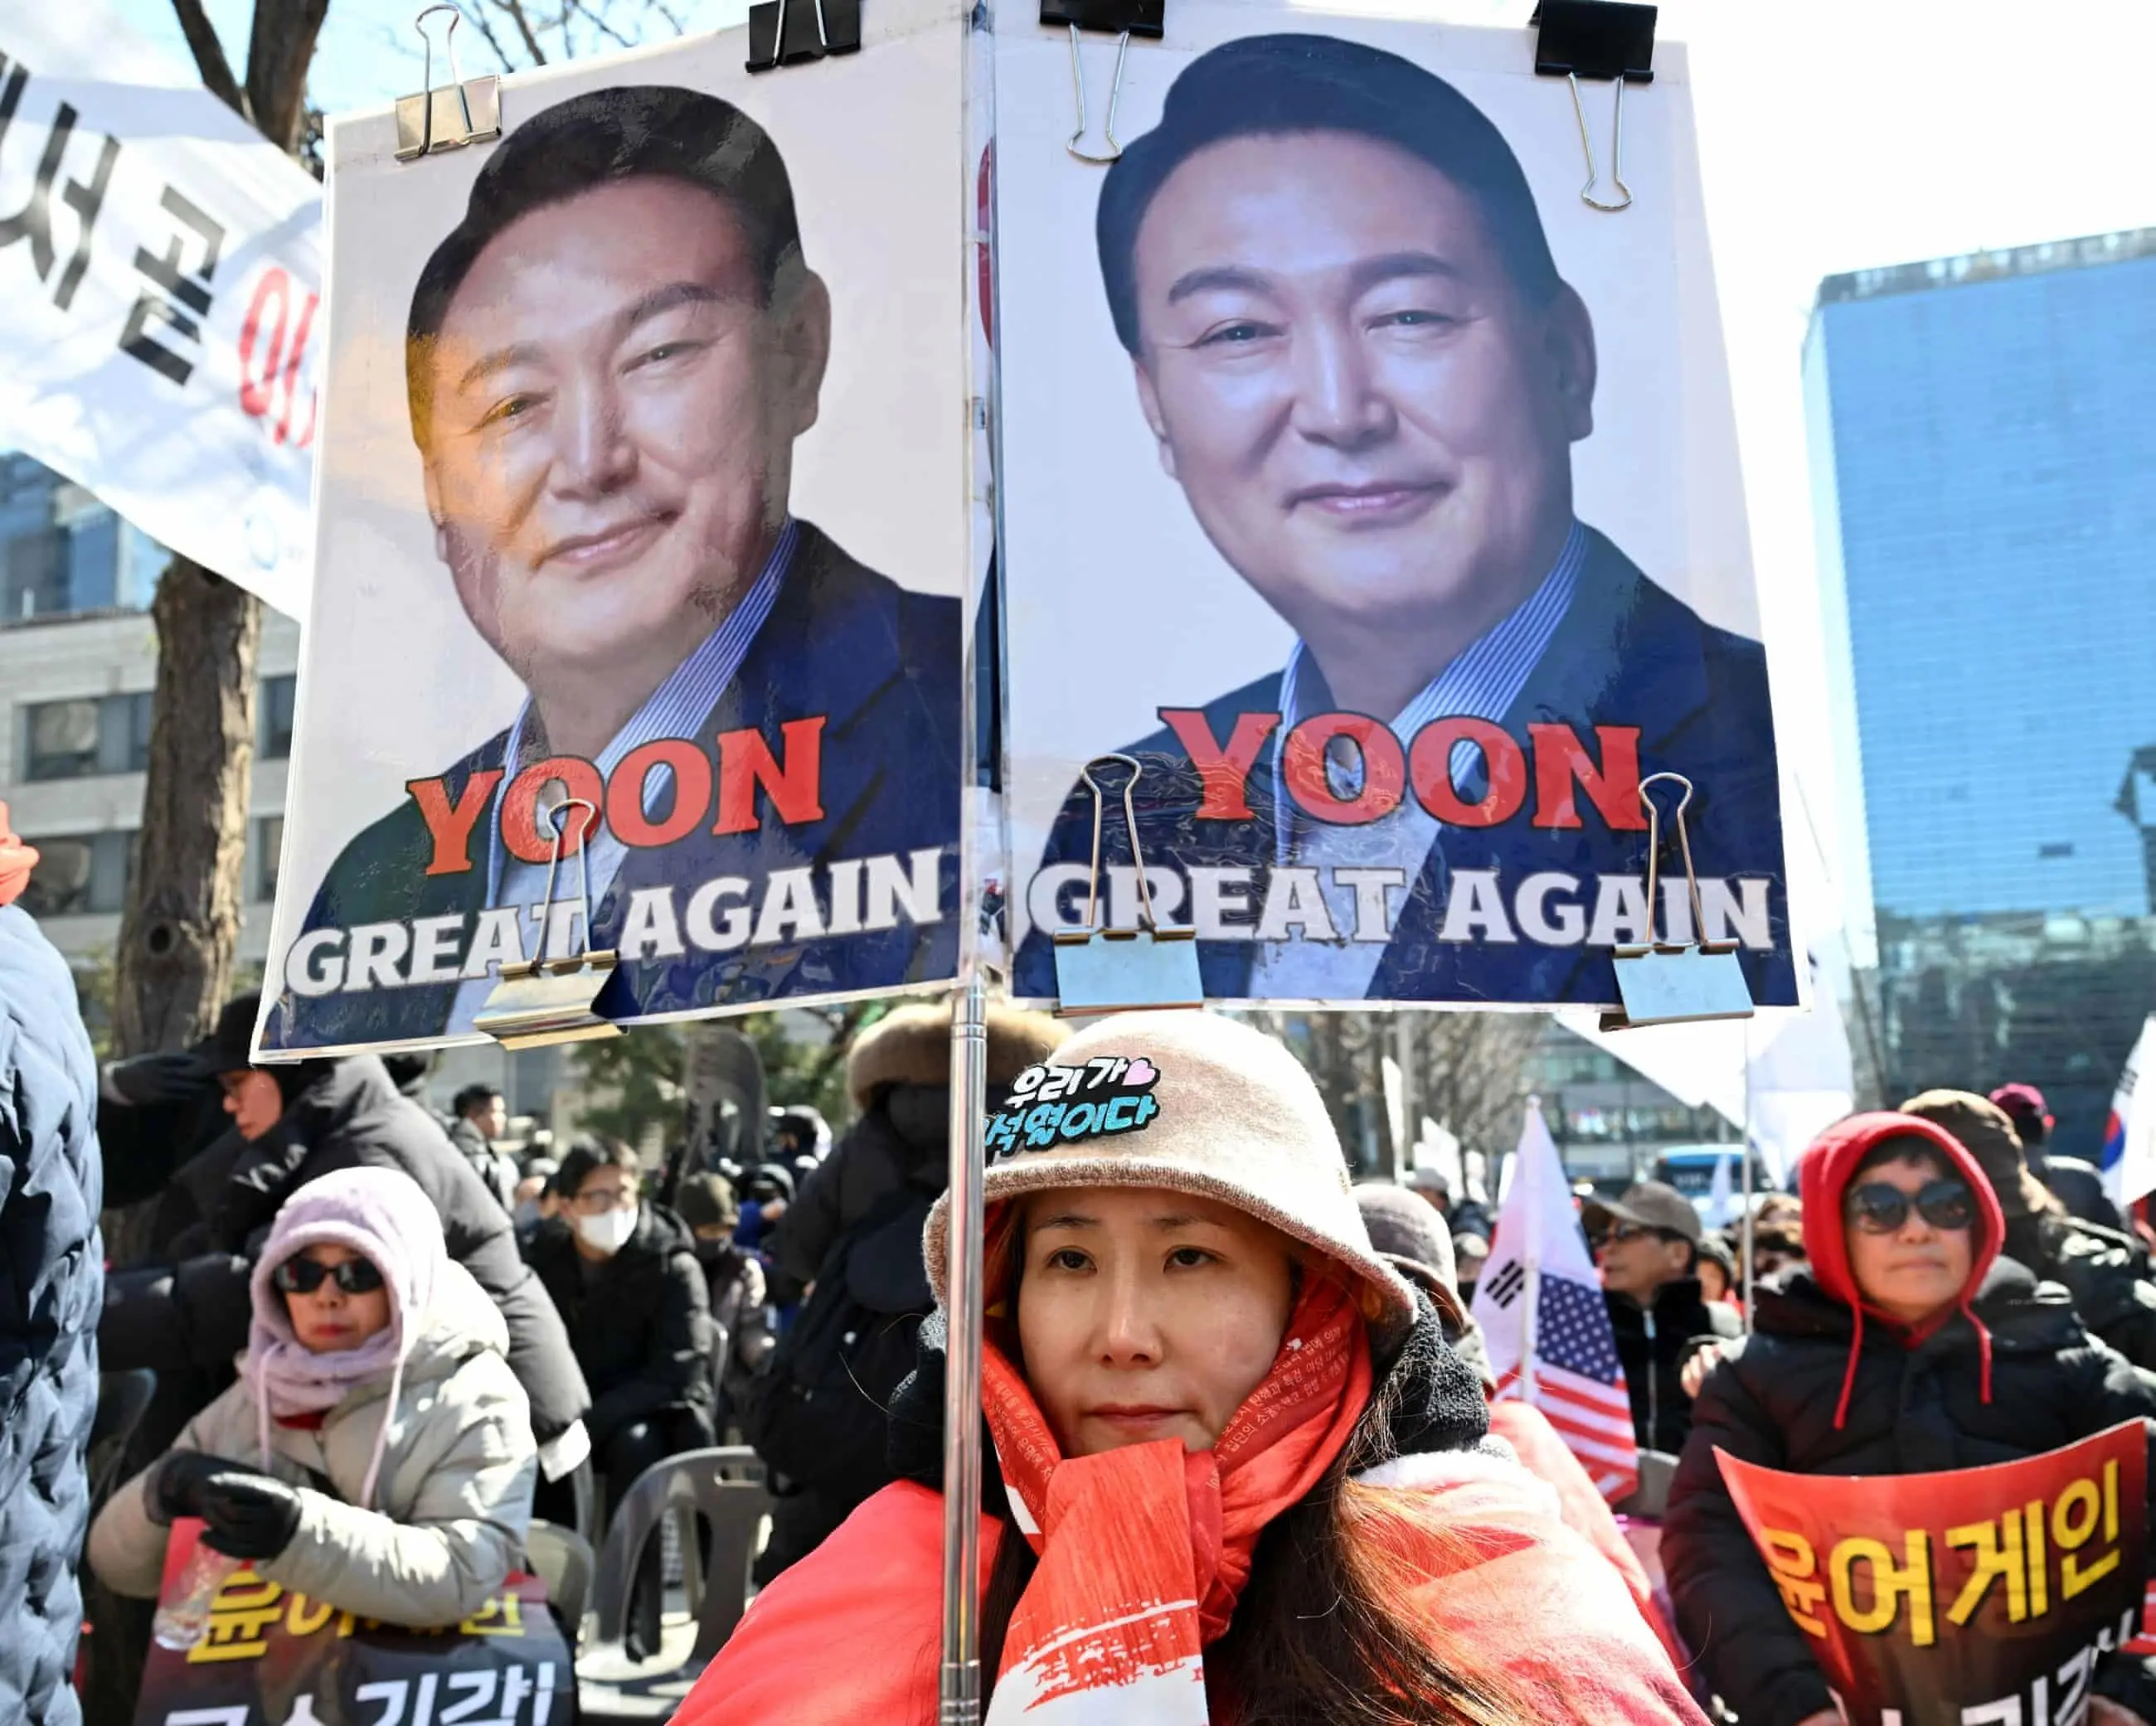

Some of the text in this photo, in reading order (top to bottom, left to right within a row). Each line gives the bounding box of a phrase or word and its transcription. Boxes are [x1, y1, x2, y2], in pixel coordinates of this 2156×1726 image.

[405, 715, 827, 875] YOON
[1157, 706, 1650, 831] YOON
[286, 846, 944, 998] GREAT AGAIN
[1027, 863, 1775, 951] GREAT AGAIN
[983, 1095, 1157, 1151] 석열이다
[1759, 1458, 2121, 1647] 윤어게인
[187, 1568, 526, 1663] 윤인
